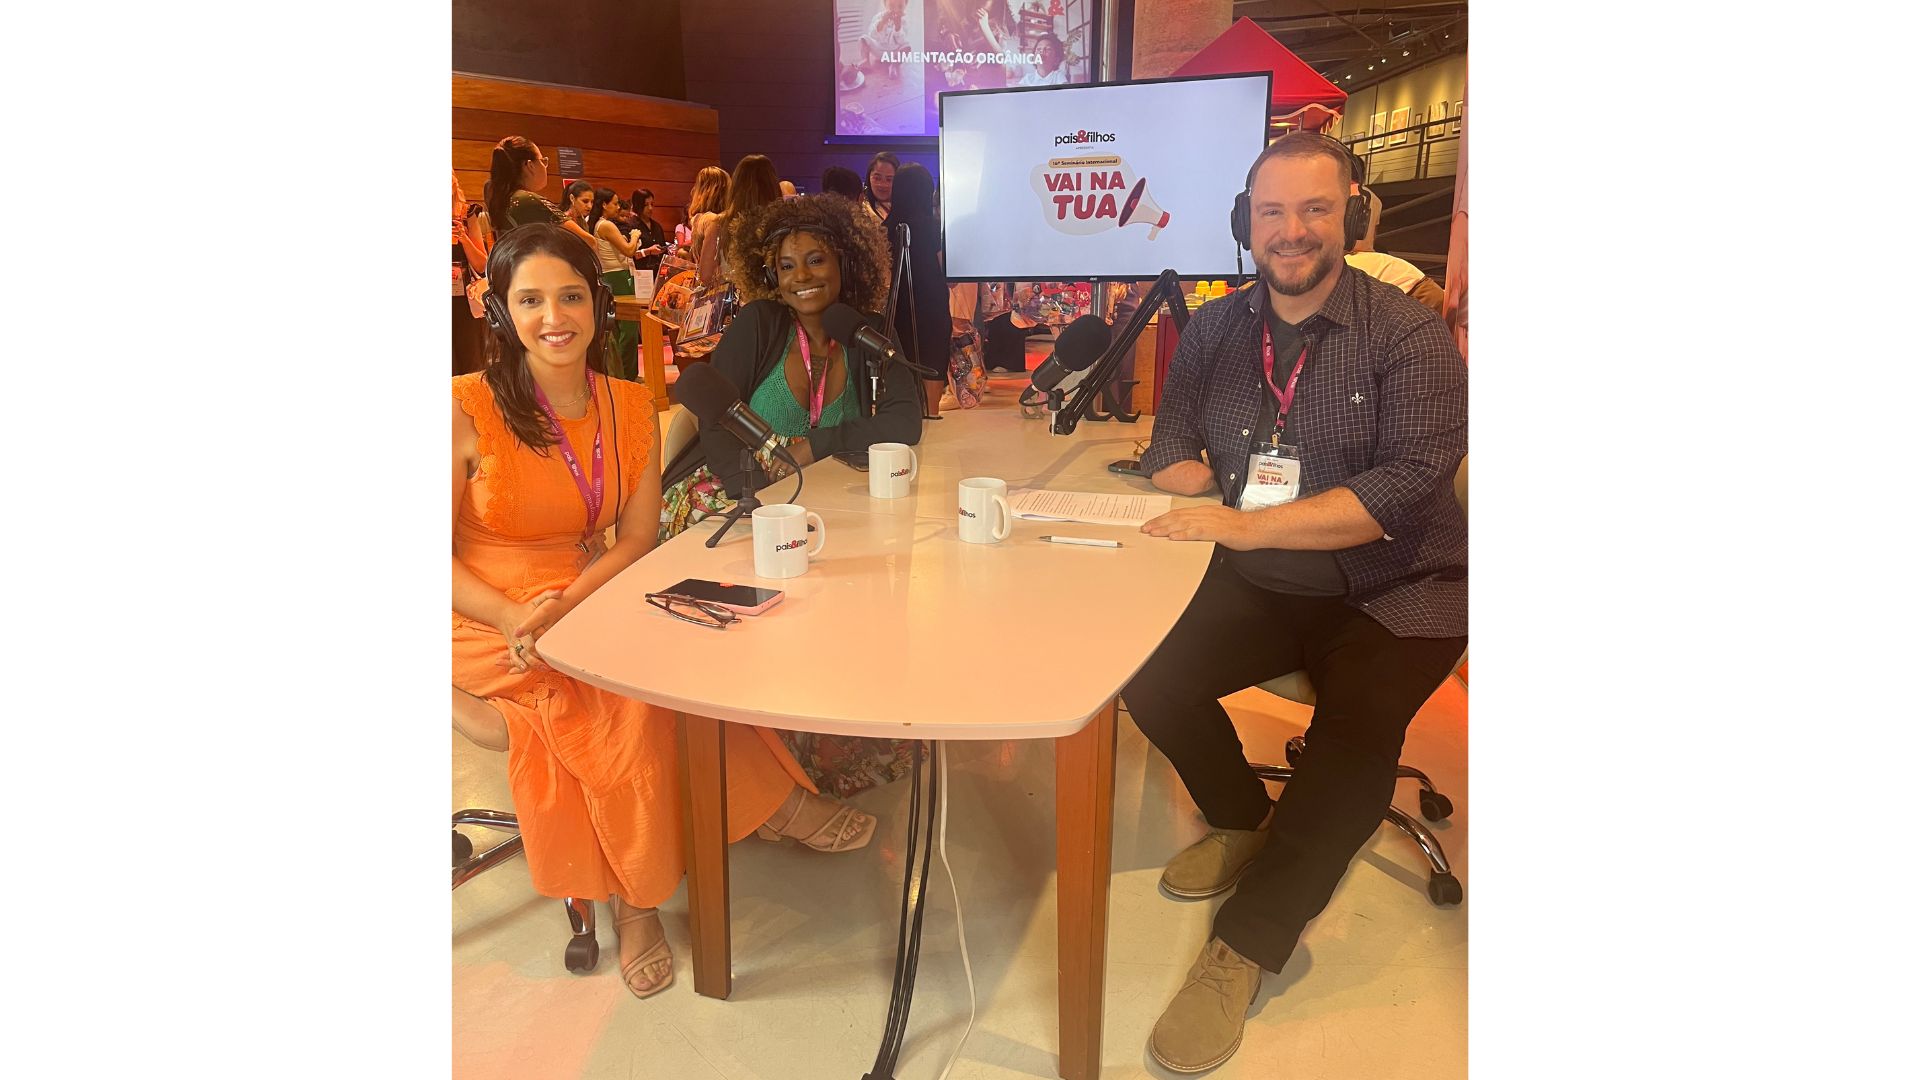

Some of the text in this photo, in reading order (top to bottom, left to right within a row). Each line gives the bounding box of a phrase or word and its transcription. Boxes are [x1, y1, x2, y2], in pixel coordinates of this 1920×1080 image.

[880, 49, 1043, 67] ALIMENTAÇÃO ORGÂNICA
[1055, 130, 1115, 146] pais&filhos
[1044, 171, 1125, 191] VAI NA
[1053, 194, 1117, 219] TUA
[1257, 473, 1270, 481] VAI
[1271, 475, 1283, 484] NA
